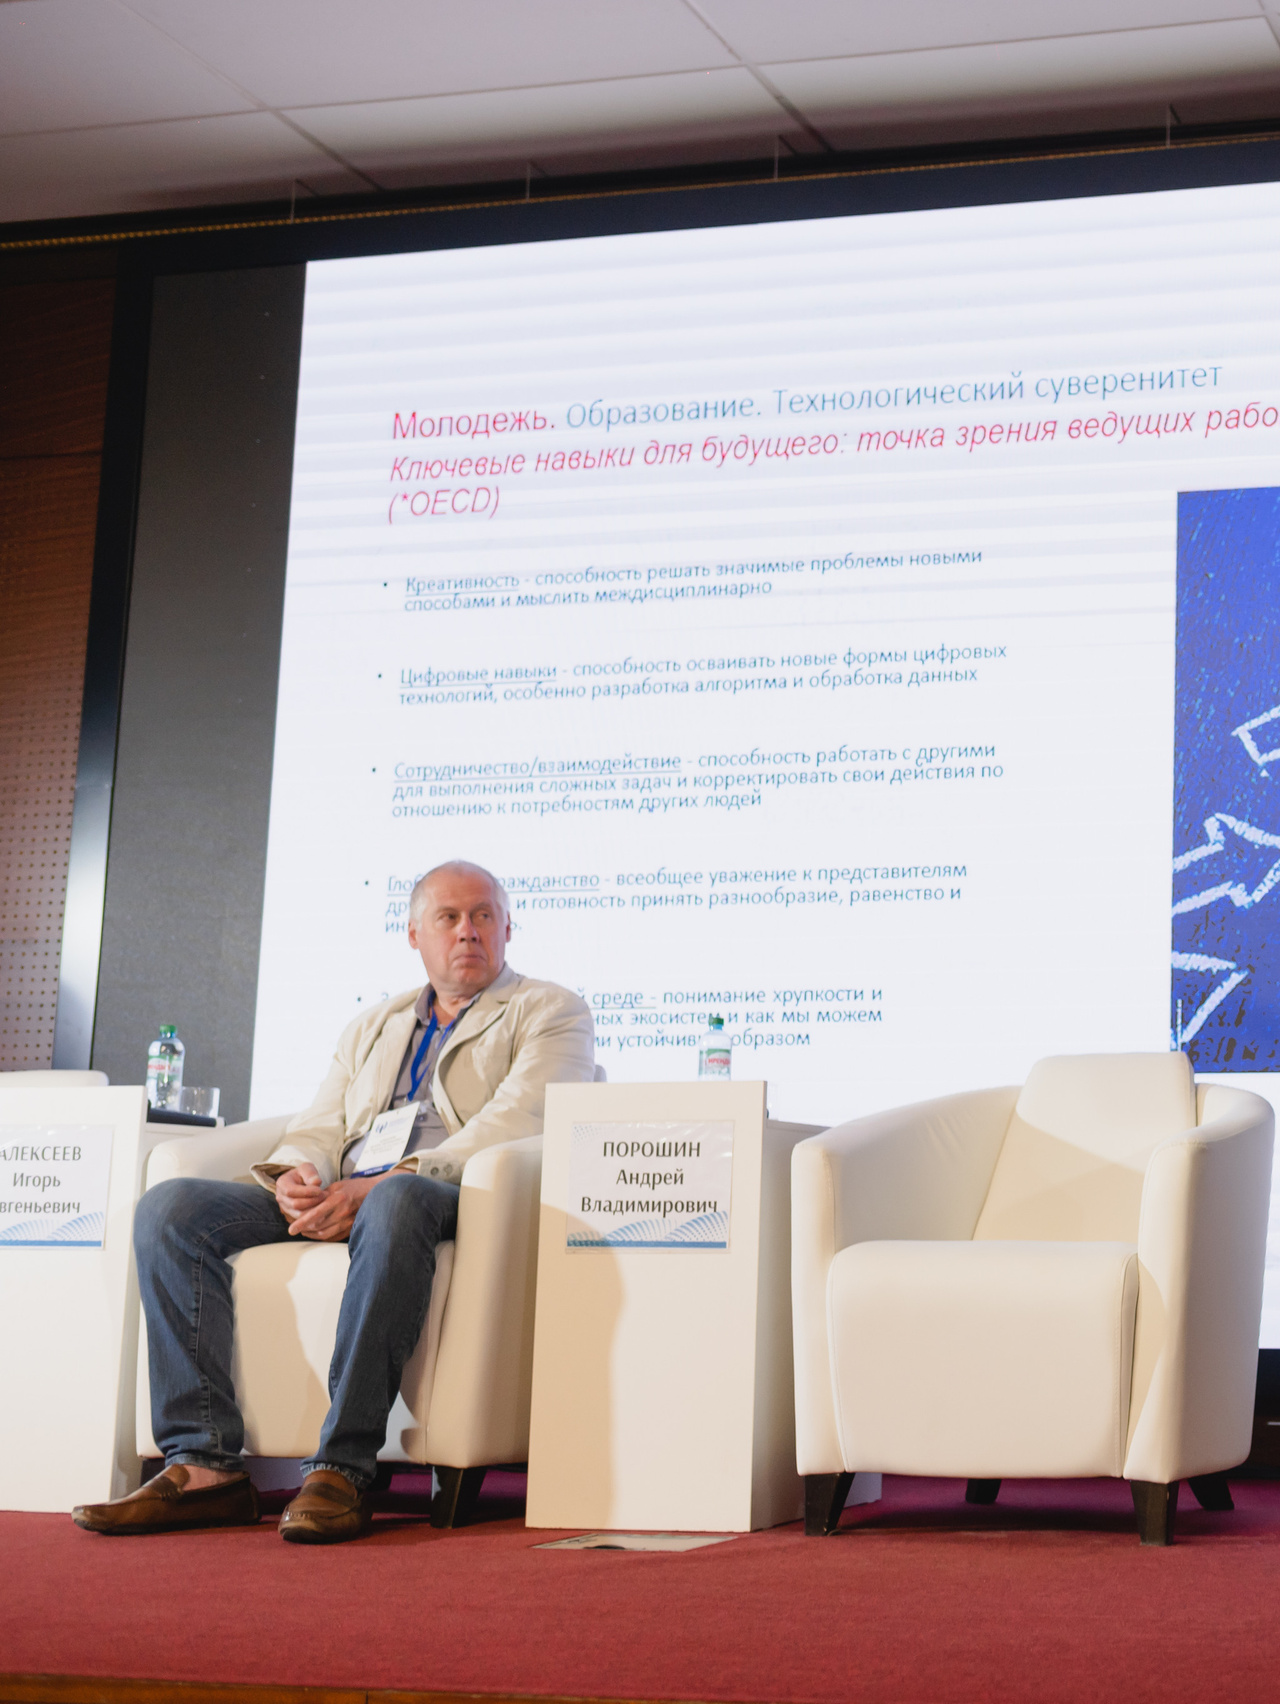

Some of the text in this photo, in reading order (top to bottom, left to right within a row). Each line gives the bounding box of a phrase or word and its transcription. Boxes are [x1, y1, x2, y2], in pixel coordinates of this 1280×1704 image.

[392, 367, 1221, 439] Молодежь. Образование. Технологический суверенитет
[390, 454, 526, 482] Ключевые
[535, 447, 635, 472] навыки
[644, 440, 693, 465] для
[702, 433, 847, 468] будущего:
[857, 427, 945, 452] точка
[955, 420, 1058, 453] зрения
[1067, 411, 1196, 444] ведущих
[406, 576, 520, 596] Креативность
[535, 565, 642, 585] способность
[647, 565, 710, 584] решать
[716, 560, 804, 576] значимые
[811, 552, 903, 575] проблемы
[909, 551, 982, 566] новыми
[404, 582, 772, 612] способами и мыслить междисциплинарно
[401, 666, 489, 688] Цифровые
[494, 666, 556, 680] навыки
[573, 656, 681, 676] способность
[686, 656, 775, 671] осваивать
[781, 653, 837, 667] новые
[843, 647, 907, 669] формы
[914, 643, 1007, 665] цифровых
[399, 667, 978, 705] технологий, особенно разработка алгоритма и обработка данных
[394, 753, 681, 783] Сотрудничество/взаимодействие
[698, 748, 811, 767] способность
[816, 744, 897, 767] работать
[902, 748, 911, 760] с
[915, 745, 995, 765] другими
[392, 765, 1004, 802] для выполнения сложных задач и корректировать свои действия по
[392, 789, 761, 818] отношению к потребностям других людей
[616, 867, 703, 888] всеобщее
[709, 869, 797, 888] уважение
[803, 869, 812, 881] к
[818, 865, 967, 885] представителям
[517, 887, 961, 911] и готовность принять разнообразие, равенство и
[592, 992, 643, 1010] среде
[663, 990, 766, 1004] понимание
[773, 989, 864, 1007] хрупкости
[872, 989, 882, 1001] и
[728, 1012, 738, 1023] и
[746, 1012, 774, 1023] как
[781, 1011, 809, 1023] мы
[817, 1010, 882, 1023] можем
[617, 1030, 702, 1052] устойчив
[731, 1029, 810, 1052] образом
[603, 1141, 701, 1157] ПОРОШИН
[13, 1172, 61, 1192] Игорь
[616, 1168, 684, 1190] Андрей
[0, 1201, 80, 1213] вгеньевич
[581, 1196, 718, 1218] Владимирович
